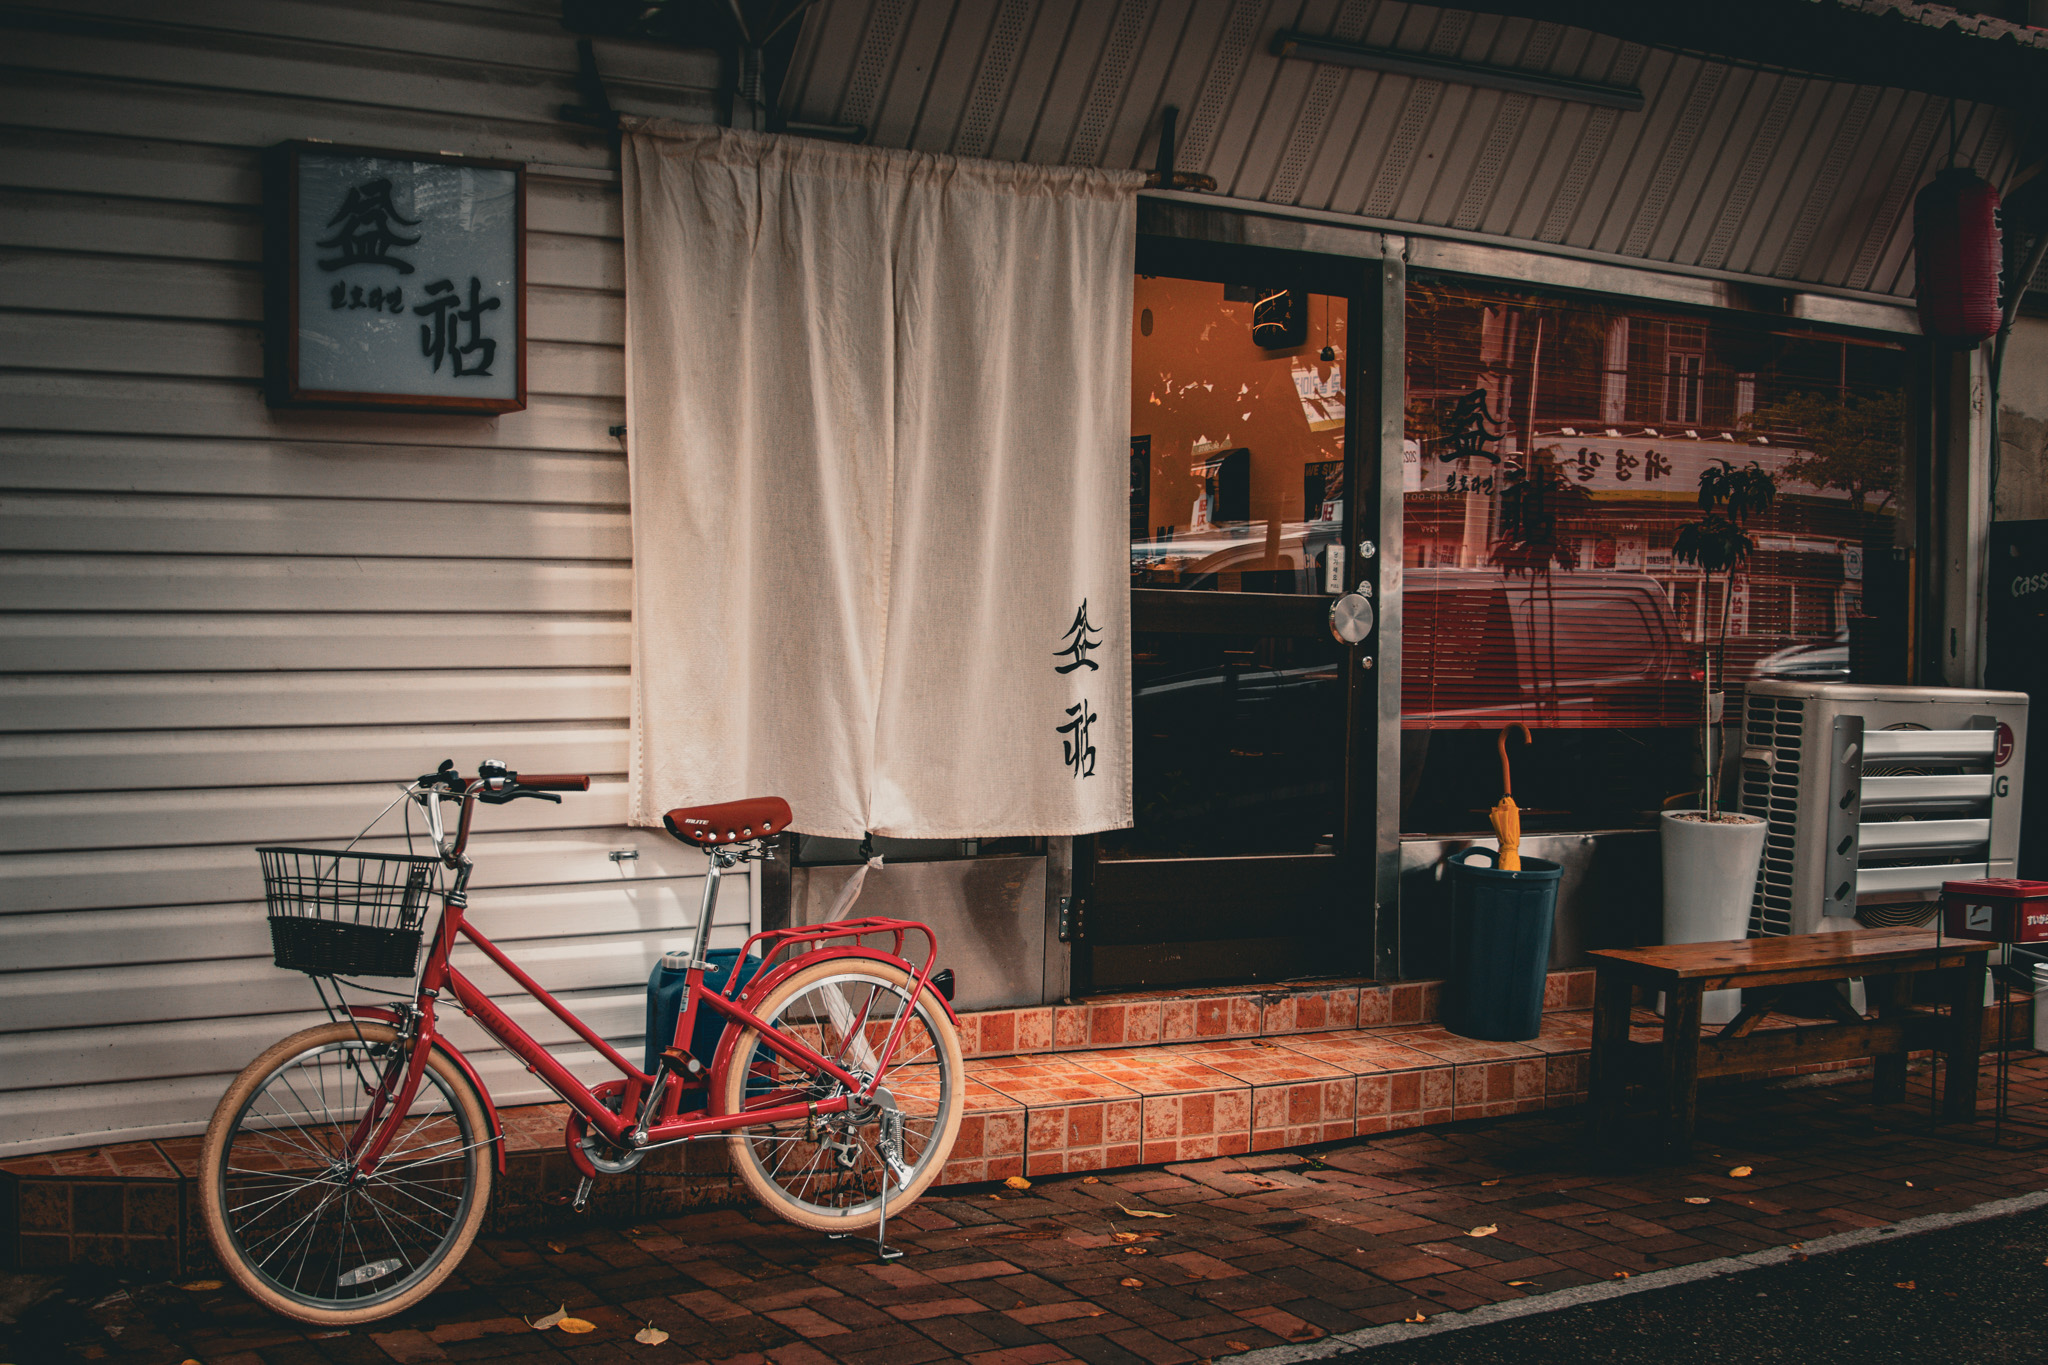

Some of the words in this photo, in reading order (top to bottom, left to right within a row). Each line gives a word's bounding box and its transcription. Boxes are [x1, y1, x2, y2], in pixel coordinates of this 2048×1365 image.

[330, 279, 404, 314] 일호라면
[1446, 470, 1495, 497] 일호라면
[1992, 775, 2009, 798] G
